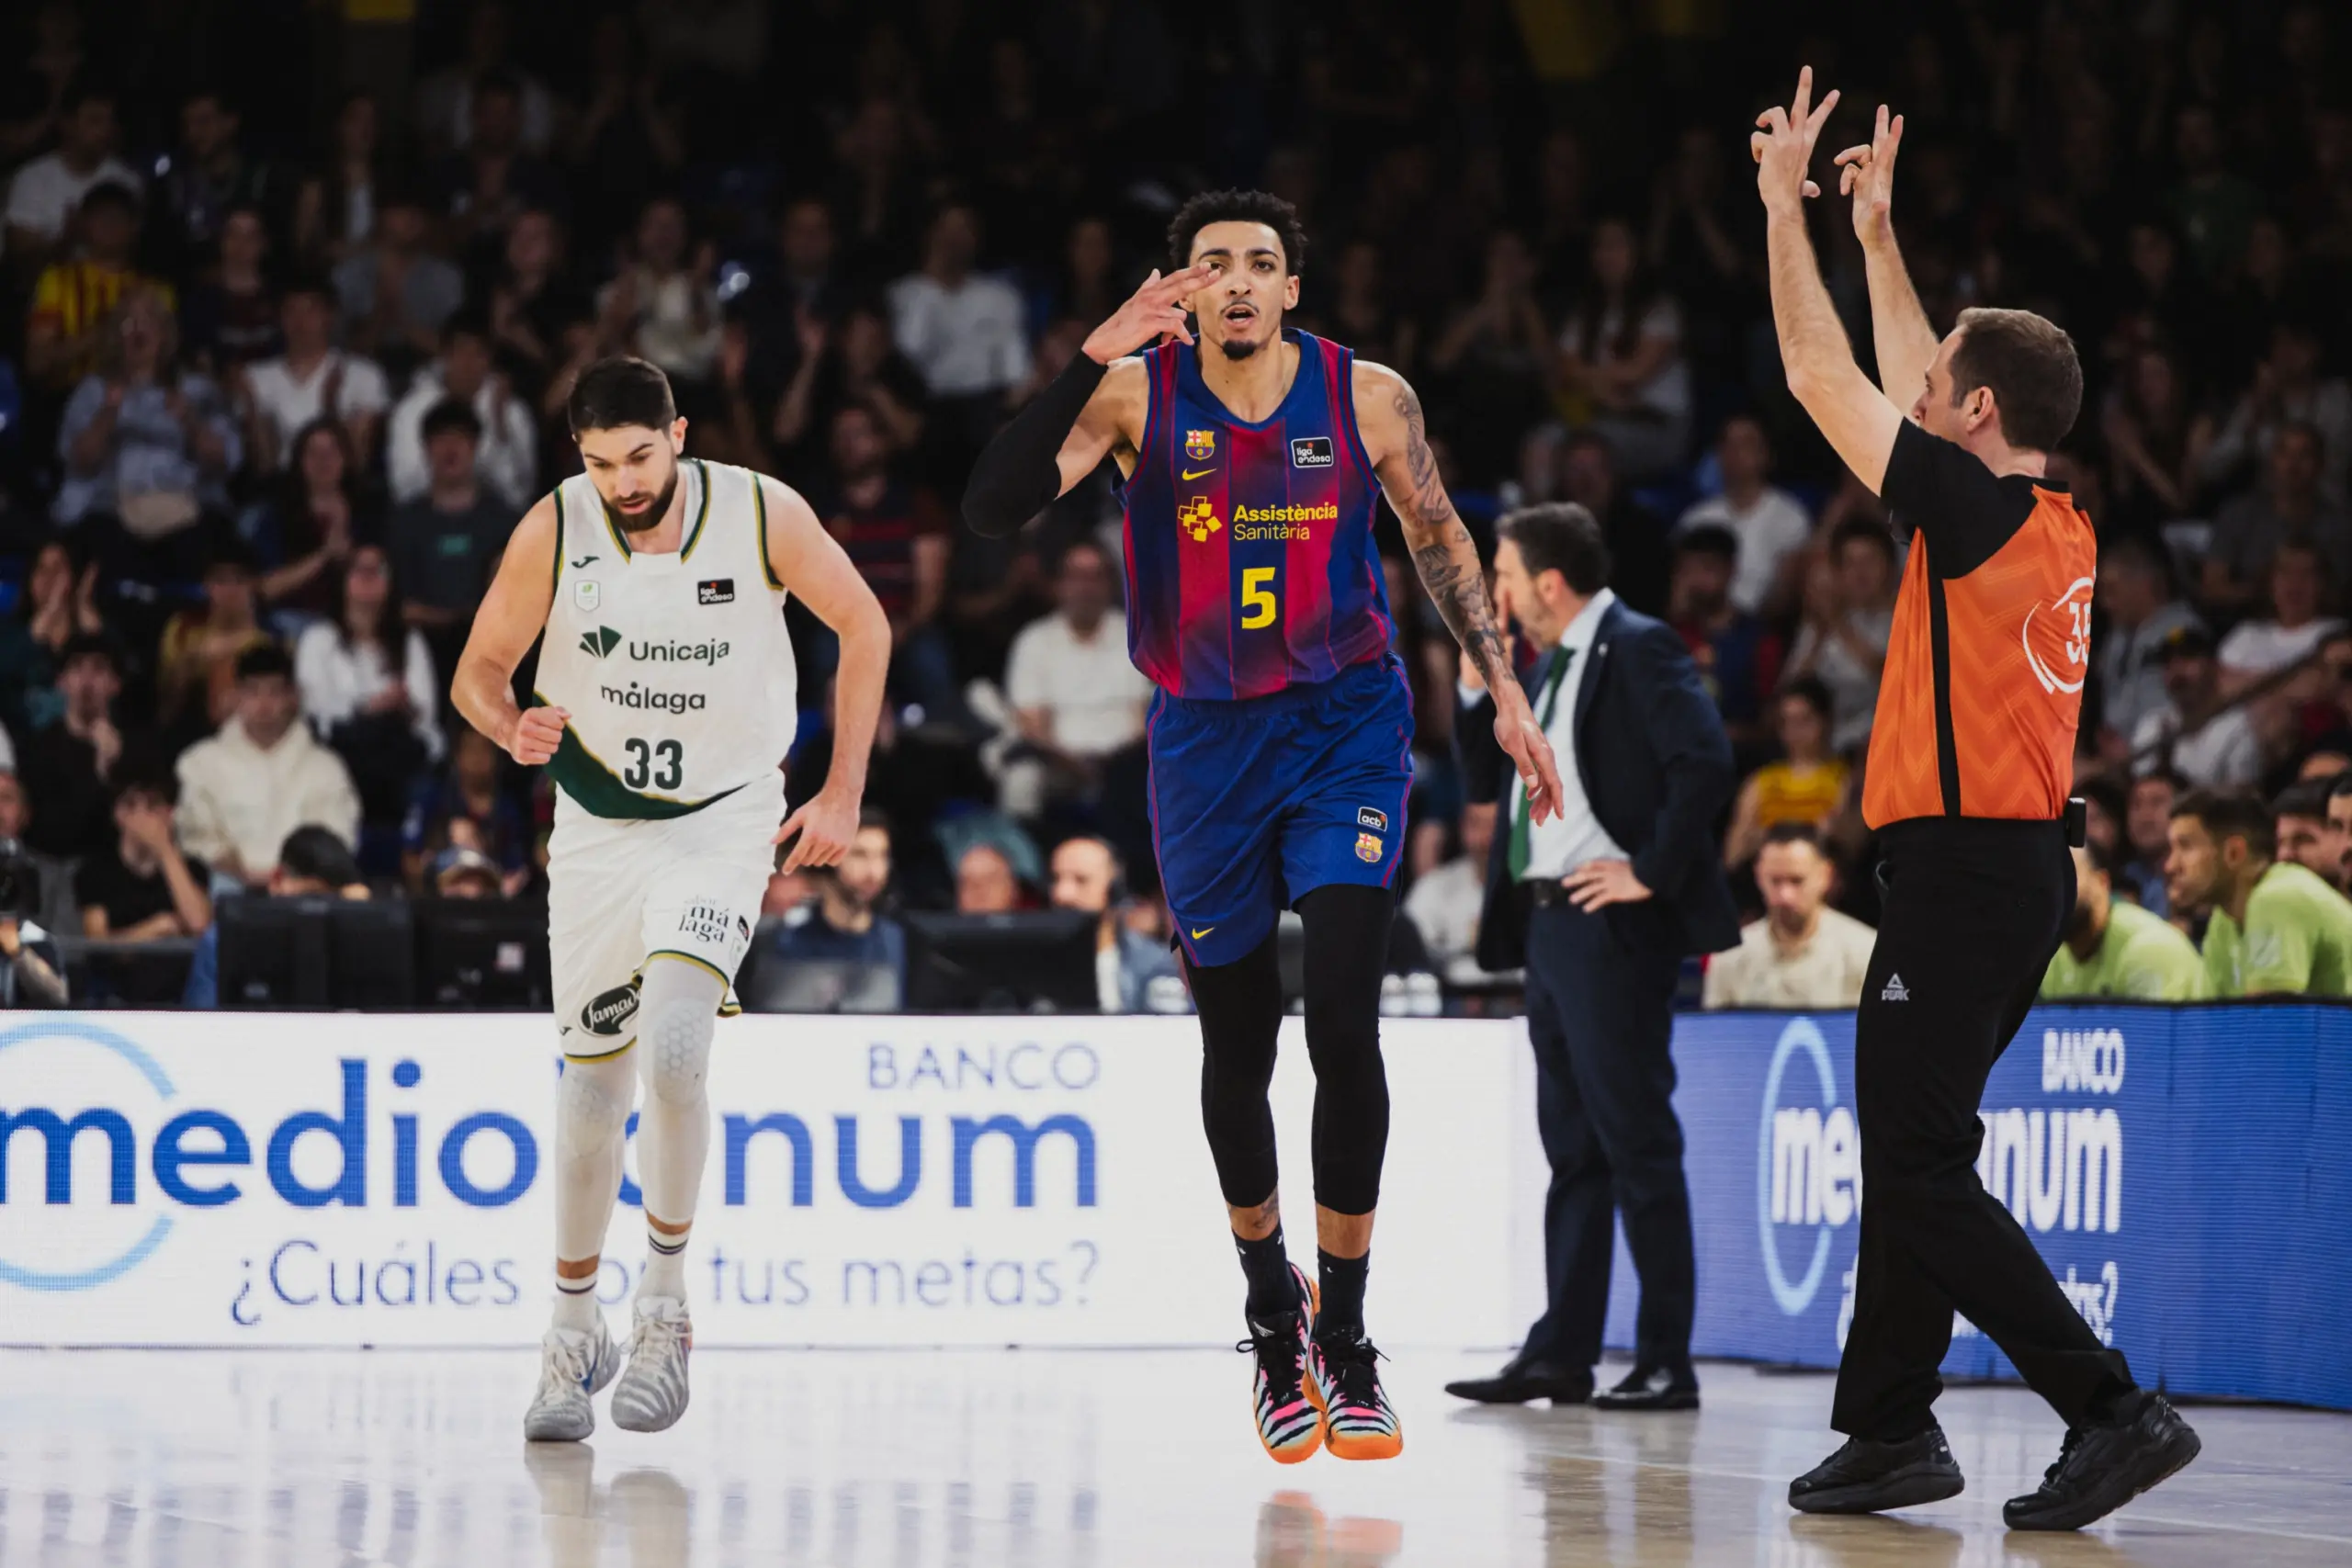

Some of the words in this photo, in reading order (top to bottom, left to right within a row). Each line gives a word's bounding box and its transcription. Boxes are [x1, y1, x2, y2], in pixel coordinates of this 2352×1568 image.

[1296, 446, 1313, 457] liga
[1297, 454, 1331, 464] endesa
[1233, 502, 1338, 523] Assistència
[1234, 524, 1310, 541] Sanitària
[700, 592, 733, 603] endesa
[1241, 566, 1277, 629] 5
[629, 638, 730, 666] Unicaja
[624, 737, 684, 791] 33
[1361, 815, 1382, 827] acb
[1881, 988, 1910, 1001] PEAK
[867, 1043, 1102, 1090] BANCO
[2041, 1027, 2126, 1094] BANCO
[0, 1058, 1099, 1208] medionum
[1770, 1106, 2123, 1234] menum
[230, 1239, 521, 1326] ¿Cuáles
[708, 1242, 810, 1306] tus
[842, 1238, 1101, 1307] metas?
